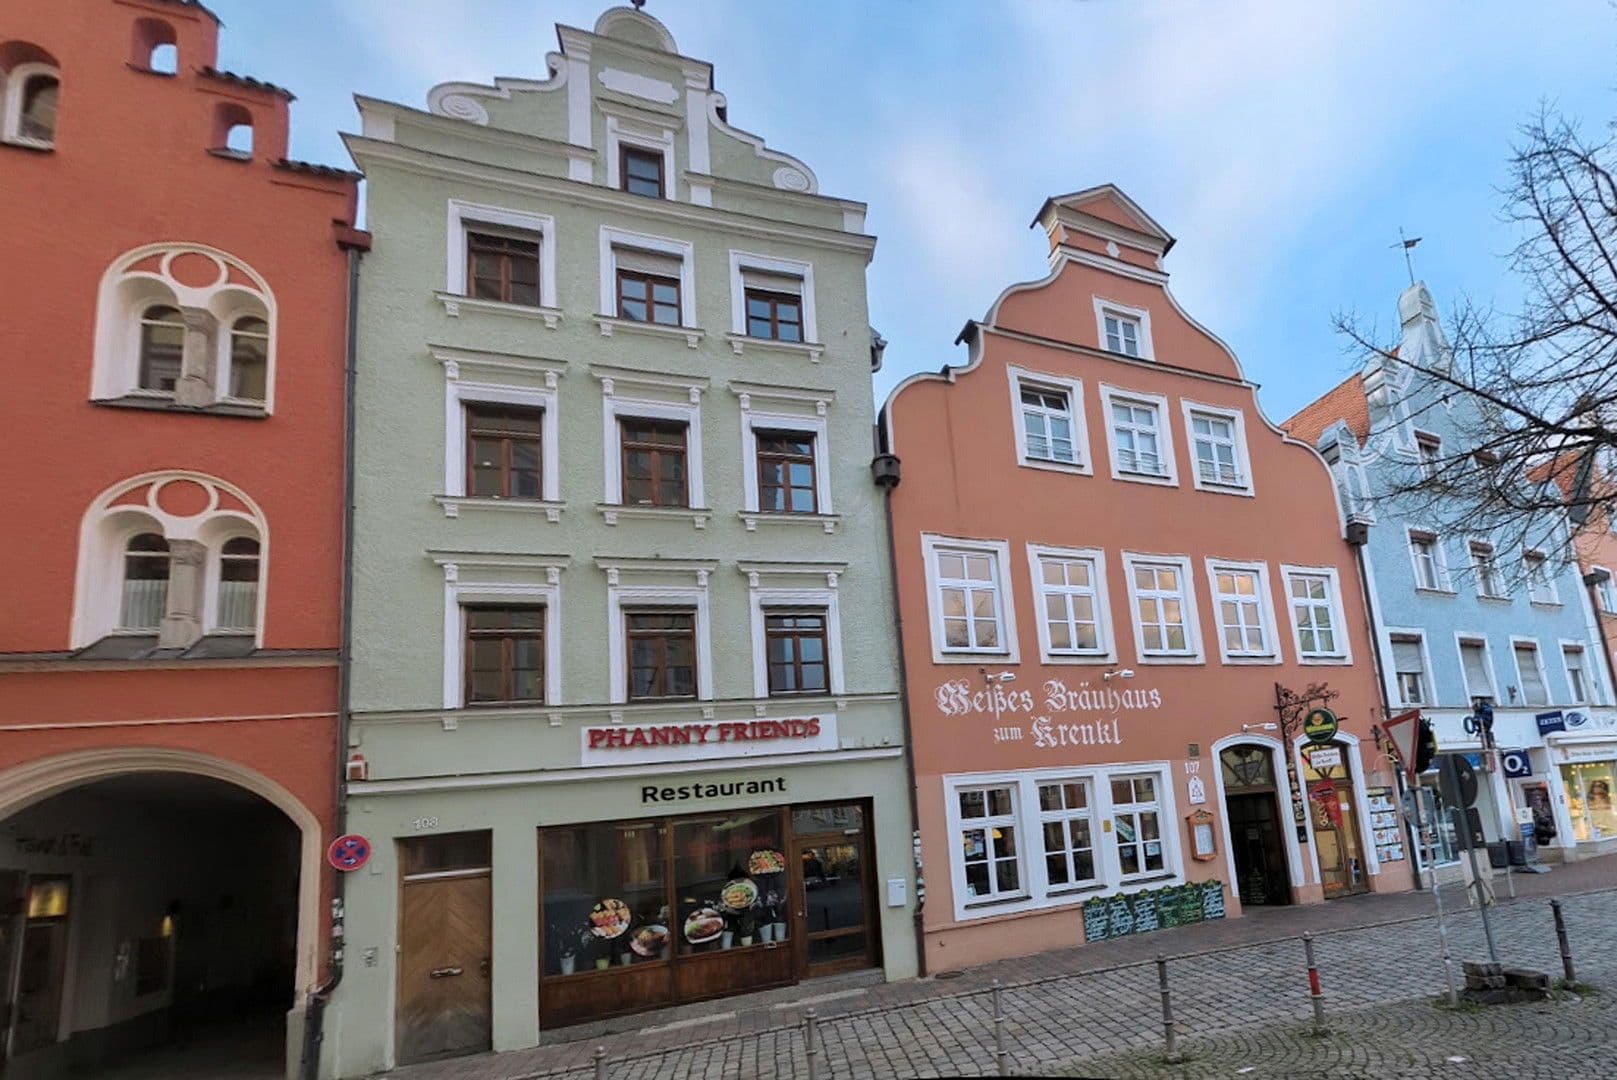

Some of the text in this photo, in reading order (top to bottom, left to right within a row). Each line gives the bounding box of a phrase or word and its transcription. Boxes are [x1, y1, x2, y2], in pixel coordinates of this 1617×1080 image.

[1043, 679, 1162, 713] Bräuhaus
[587, 717, 821, 749] PHANNY FRIENDS
[993, 715, 1123, 748] zum Krenkl
[1184, 761, 1200, 774] 107
[641, 777, 787, 803] Restaurant
